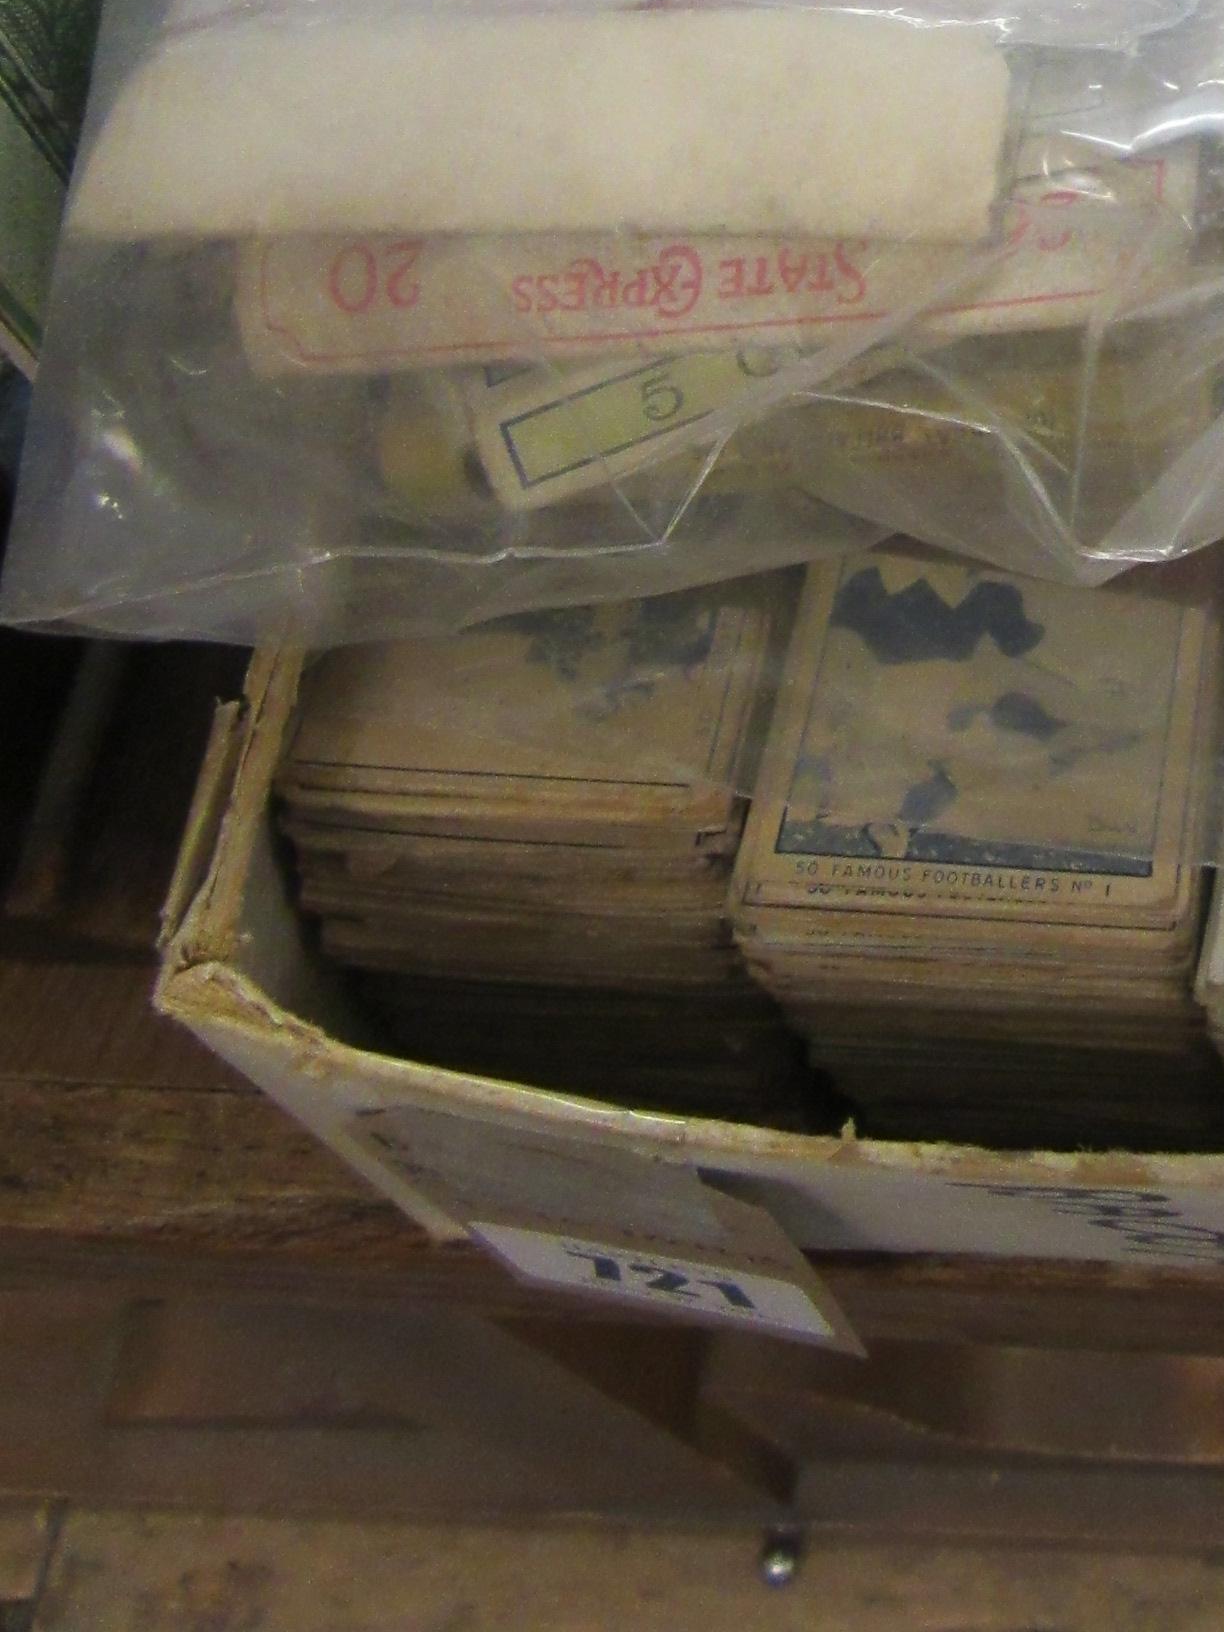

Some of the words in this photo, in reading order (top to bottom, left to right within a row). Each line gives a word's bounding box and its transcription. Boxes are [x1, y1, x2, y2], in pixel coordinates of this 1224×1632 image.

[329, 238, 423, 317] 20
[715, 240, 870, 304] STATE
[642, 372, 685, 422] 5
[796, 861, 818, 876] 50
[832, 863, 912, 882] FAMOUS
[921, 868, 1060, 892] FOOTBALLERS
[1105, 883, 1111, 897] 1
[565, 1246, 760, 1317] 121
